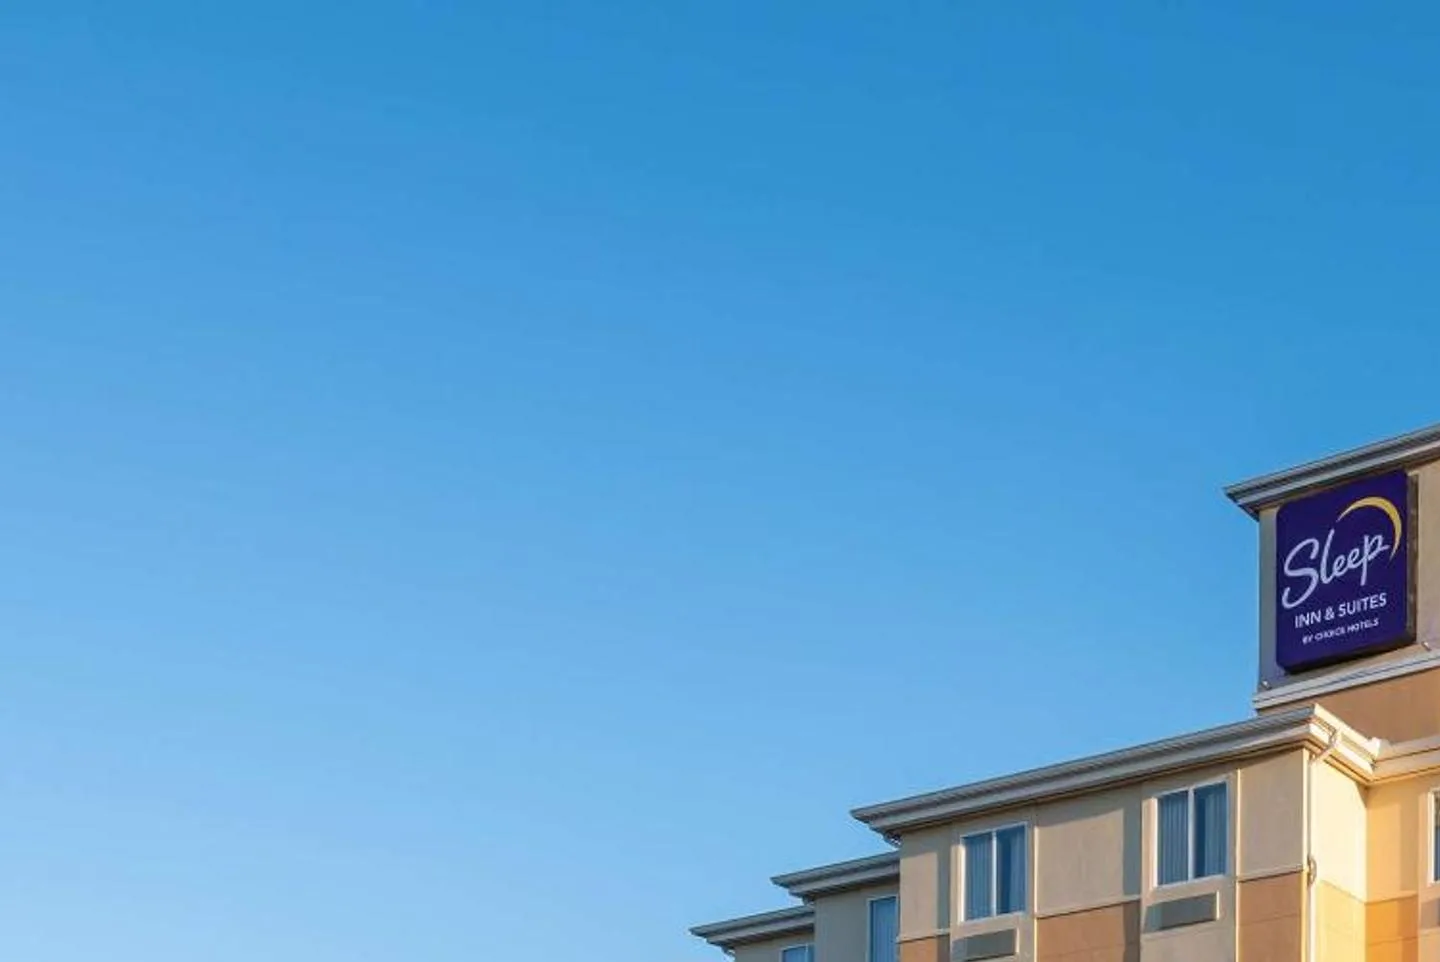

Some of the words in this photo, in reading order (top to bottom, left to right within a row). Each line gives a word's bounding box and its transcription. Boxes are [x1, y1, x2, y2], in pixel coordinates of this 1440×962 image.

[1281, 528, 1390, 609] Sleep
[1294, 609, 1322, 629] INN
[1324, 606, 1335, 621] &
[1338, 592, 1388, 617] SUITES
